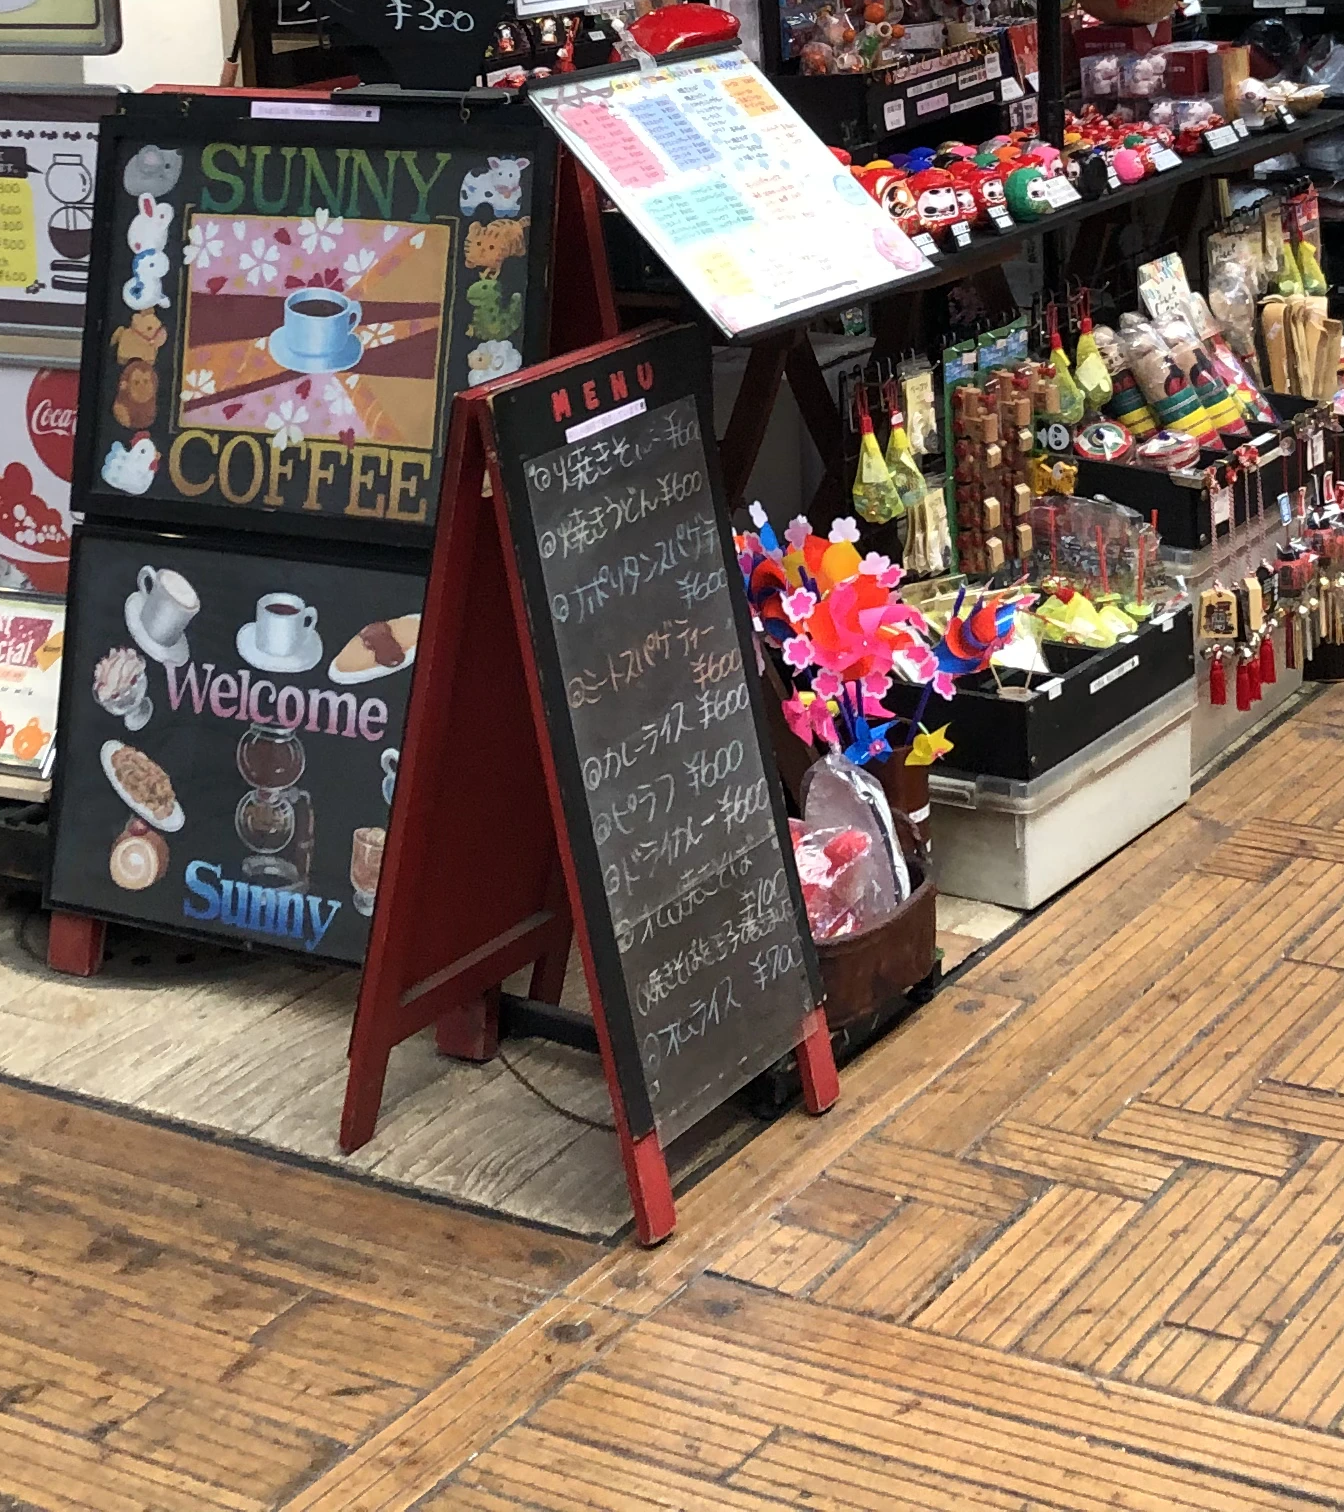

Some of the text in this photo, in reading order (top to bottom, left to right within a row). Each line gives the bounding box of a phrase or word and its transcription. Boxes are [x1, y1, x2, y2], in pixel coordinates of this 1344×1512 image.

[200, 141, 452, 221] SUNNY
[551, 362, 654, 422] MENU
[169, 430, 432, 523] COFFEE
[558, 471, 703, 558] 焼きうどん ¥600
[164, 661, 389, 742] Welcome
[603, 682, 750, 780] カレーライス ¥600
[608, 740, 744, 835] ピラフ ¥600
[718, 777, 769, 834] ¥600
[183, 859, 342, 952] Sunny
